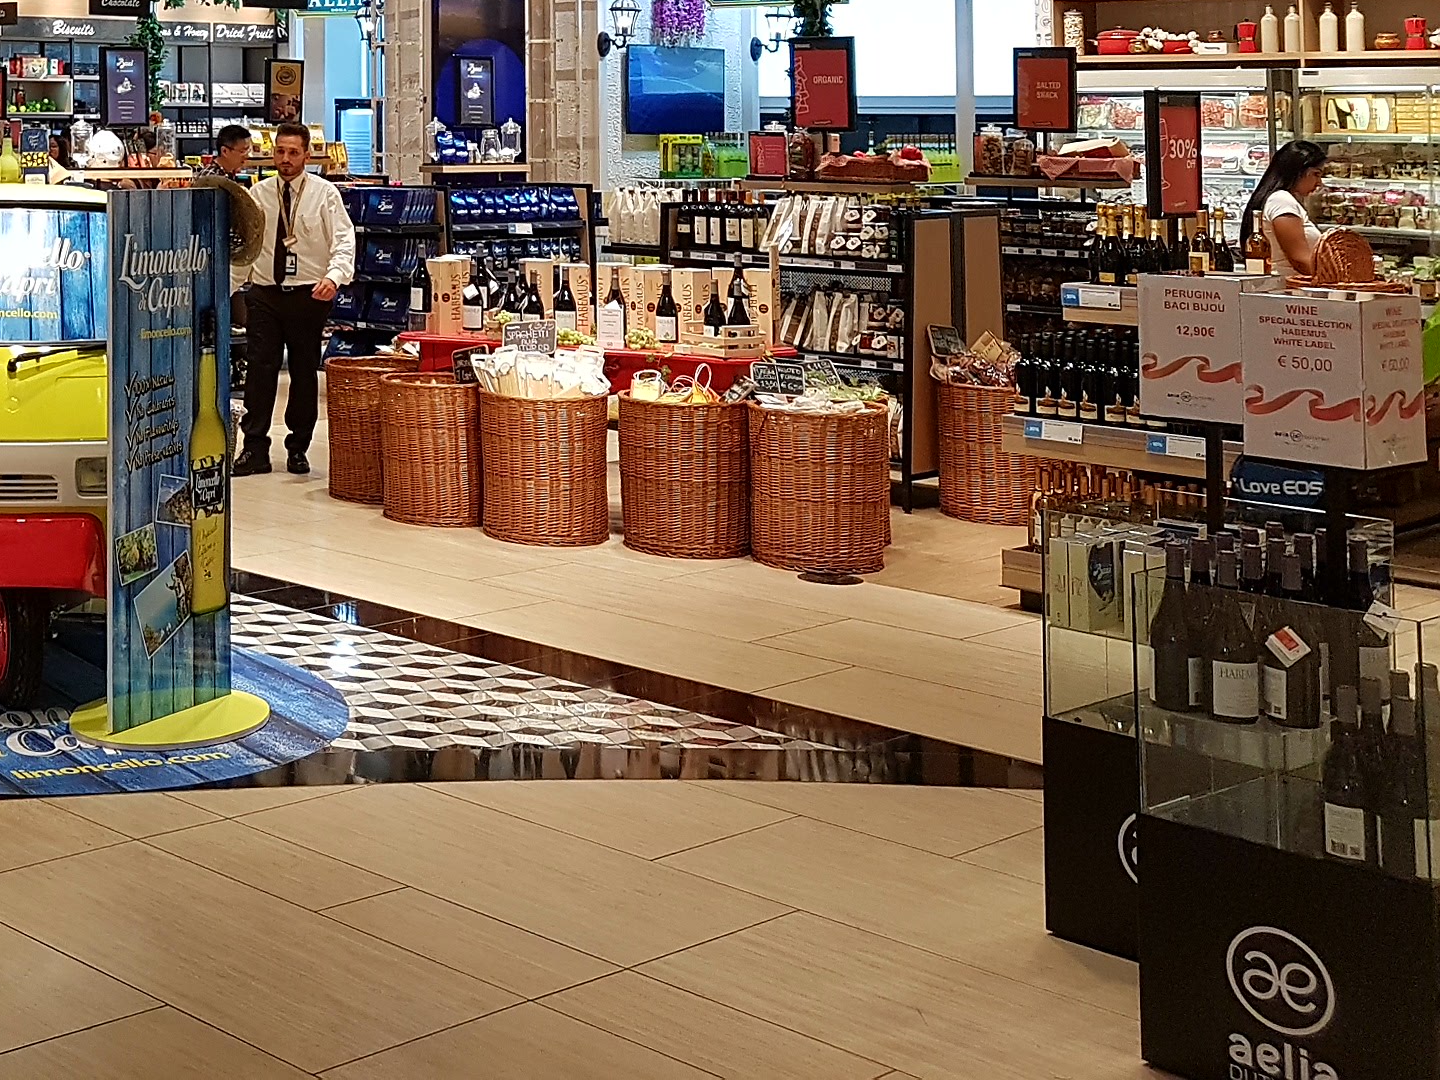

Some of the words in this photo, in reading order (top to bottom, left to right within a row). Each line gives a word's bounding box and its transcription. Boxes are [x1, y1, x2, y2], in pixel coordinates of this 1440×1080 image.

[52, 20, 95, 36] Biscuits
[184, 24, 210, 40] Honey
[216, 24, 244, 40] Dried
[247, 24, 274, 41] Fruit
[812, 75, 844, 84] ORGANIC
[1036, 81, 1061, 89] SALTED
[1169, 138, 1198, 159] 30%
[118, 233, 209, 290] Limoncello
[147, 277, 190, 318] Capri
[451, 273, 461, 321] HABEMUS
[1164, 288, 1222, 301] PERUGINA
[578, 278, 588, 327] HABEMUS
[683, 284, 692, 322] ABEMUS
[1163, 300, 1190, 311] BACI
[1192, 301, 1226, 313] BIJOU
[1285, 304, 1318, 316] WINE
[1258, 315, 1298, 326] SPECIAL
[1299, 319, 1353, 330] SELECTION
[140, 326, 192, 340] limoncello.com
[506, 329, 549, 341] SPAGHETTI
[1175, 324, 1216, 338] 12,90€
[1281, 327, 1328, 339] HABEMUS
[1273, 336, 1303, 347] WHITE
[1304, 339, 1336, 350] LABEL
[1277, 354, 1288, 368] €
[1291, 355, 1333, 372] 50,00
[1239, 477, 1280, 495] Love
[1283, 480, 1323, 495] EOS
[1219, 667, 1254, 680] HABEM
[10, 750, 231, 781] limoncello.com
